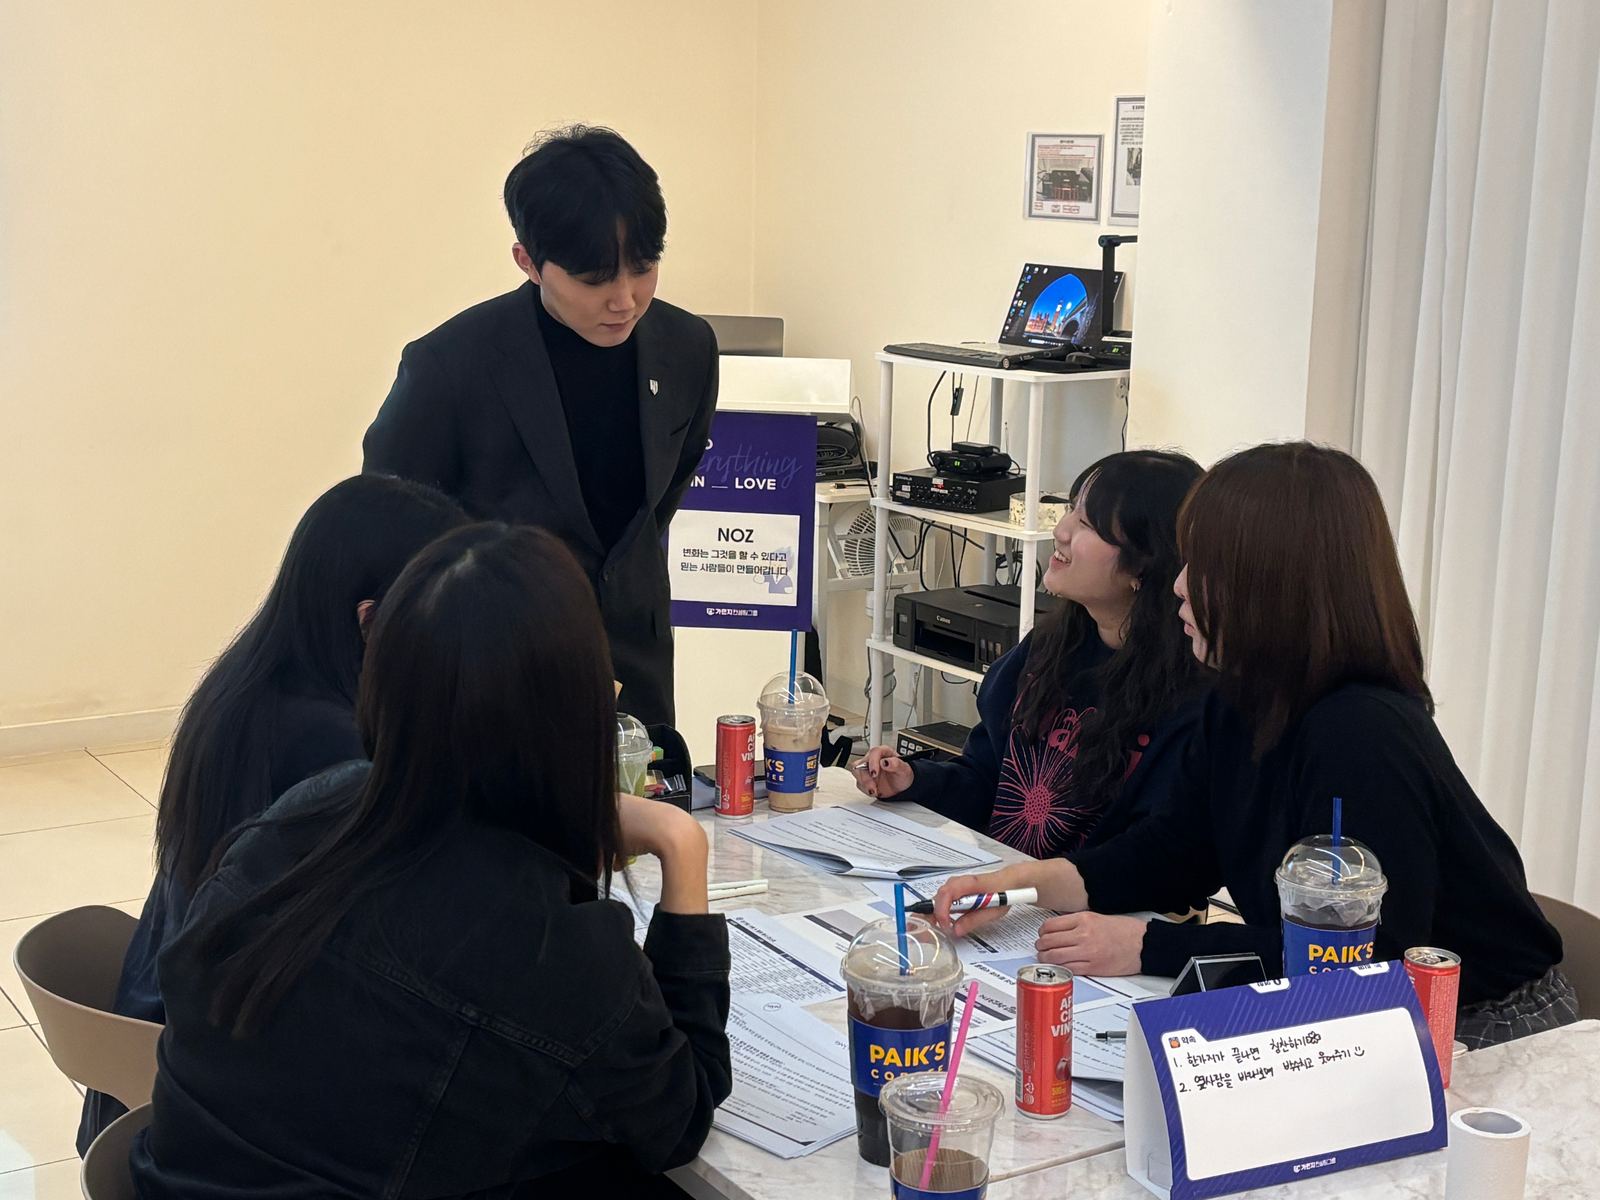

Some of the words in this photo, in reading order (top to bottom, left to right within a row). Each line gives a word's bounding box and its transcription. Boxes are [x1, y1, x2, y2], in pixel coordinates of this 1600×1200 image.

[735, 477, 777, 491] LOVE
[717, 527, 754, 543] NOZ
[682, 548, 709, 558] 변화는
[710, 549, 737, 559] 그것을
[739, 551, 748, 560] 할
[750, 552, 759, 560] 수
[760, 552, 787, 561] 있다고
[680, 562, 698, 571] 믿는
[700, 563, 735, 573] 사람들이
[736, 564, 788, 575] 만들어갑니다
[1308, 941, 1375, 963] PAIK'S
[869, 1041, 946, 1067] PAIK'S
[1173, 1057, 1183, 1068] 1.
[1186, 1051, 1225, 1068] 한가지가
[1231, 1046, 1261, 1064] 끝나면
[1269, 1036, 1306, 1054] 칭찬하기
[1179, 1082, 1192, 1093] 2.
[1194, 1072, 1233, 1091] 옆사람을
[1237, 1066, 1274, 1081] 바라보며
[1282, 1057, 1314, 1072] 박수치고
[1318, 1049, 1351, 1065] 웃어주기
